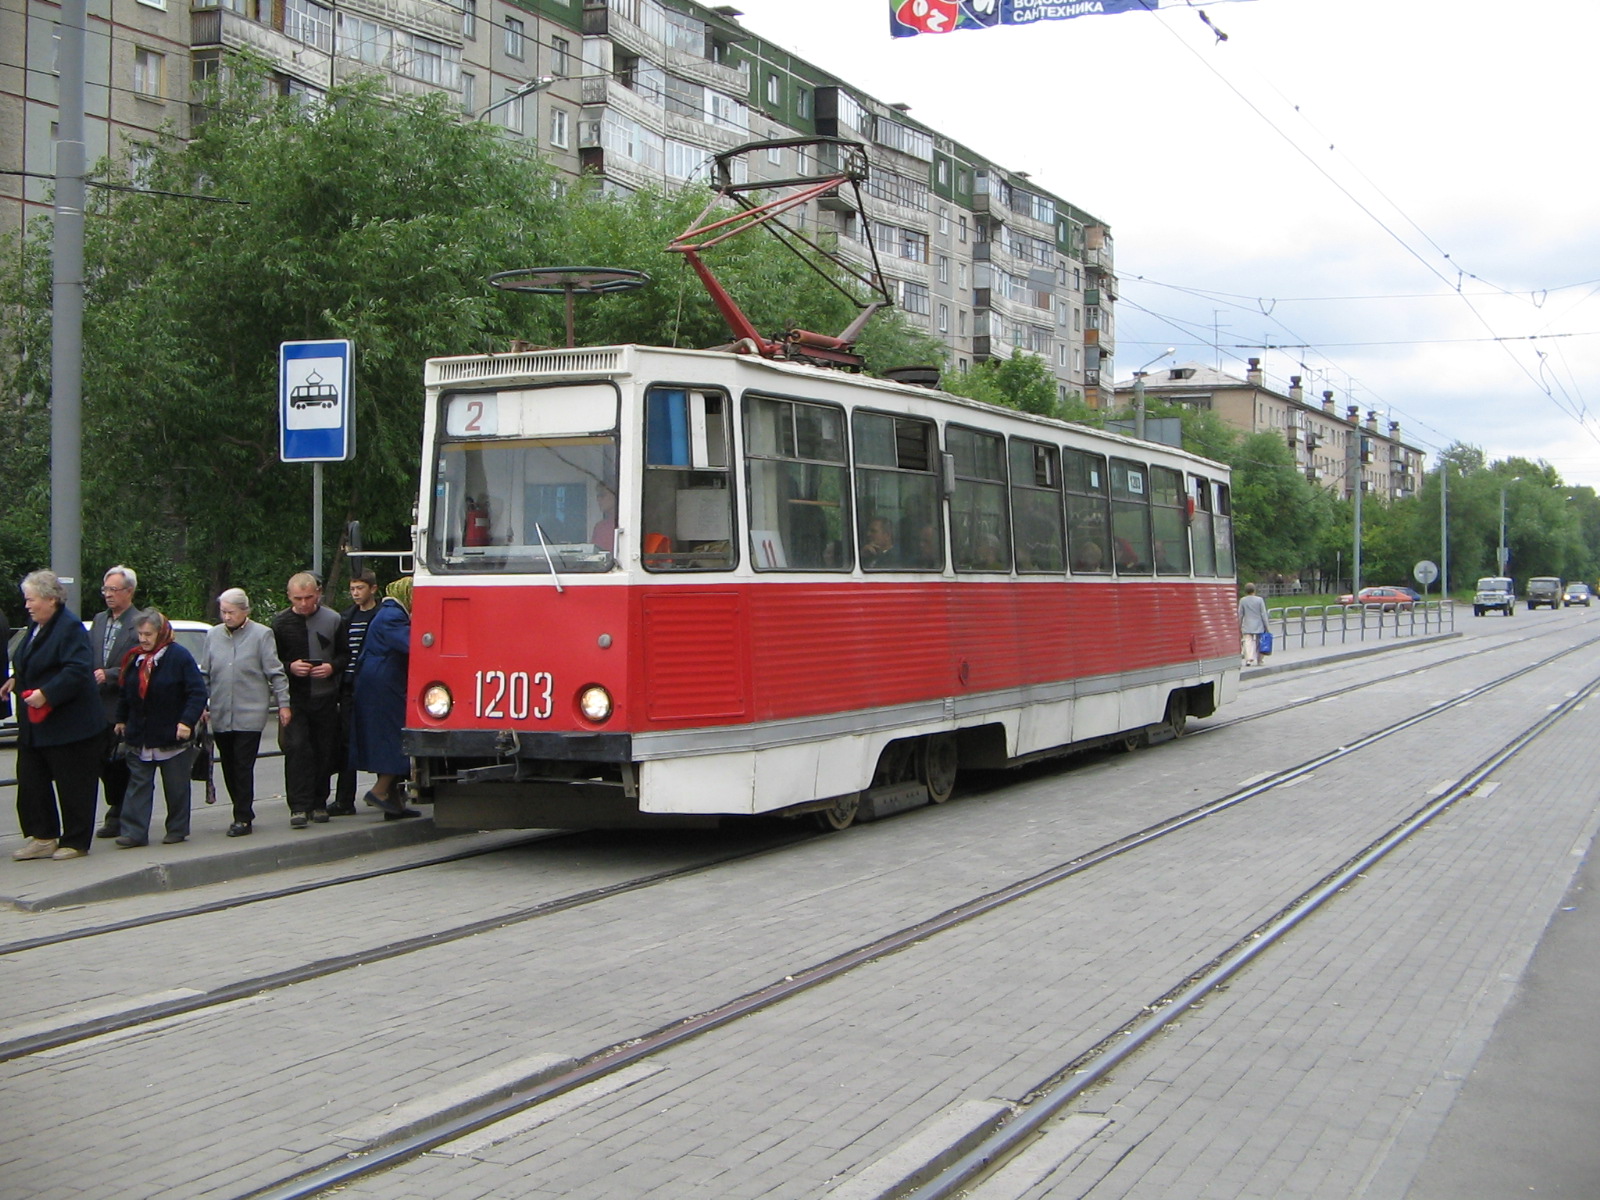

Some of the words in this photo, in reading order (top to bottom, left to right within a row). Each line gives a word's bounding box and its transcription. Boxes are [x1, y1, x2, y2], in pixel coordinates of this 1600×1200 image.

[1013, 2, 1104, 22] САНТЕХНИКА
[465, 401, 484, 431] 2
[475, 670, 553, 719] 1203
